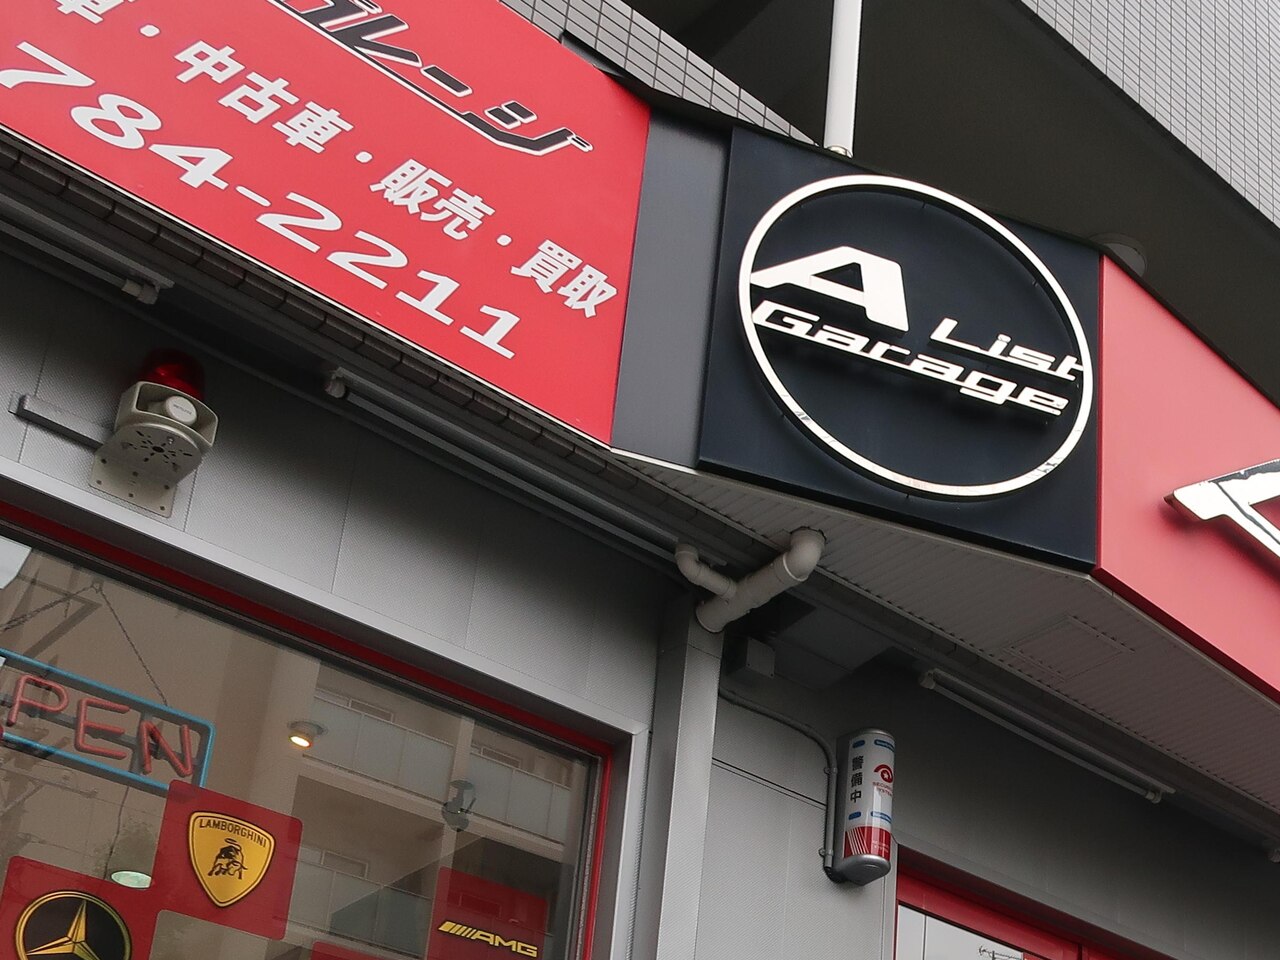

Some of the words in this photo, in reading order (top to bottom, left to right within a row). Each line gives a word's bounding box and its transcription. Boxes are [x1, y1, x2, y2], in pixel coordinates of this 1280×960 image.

[749, 246, 909, 332] A
[929, 317, 1085, 381] List
[751, 299, 1071, 416] Garage
[850, 755, 864, 803] 警備中
[199, 819, 267, 848] LAMBORGHINI
[470, 930, 538, 958] AMG
